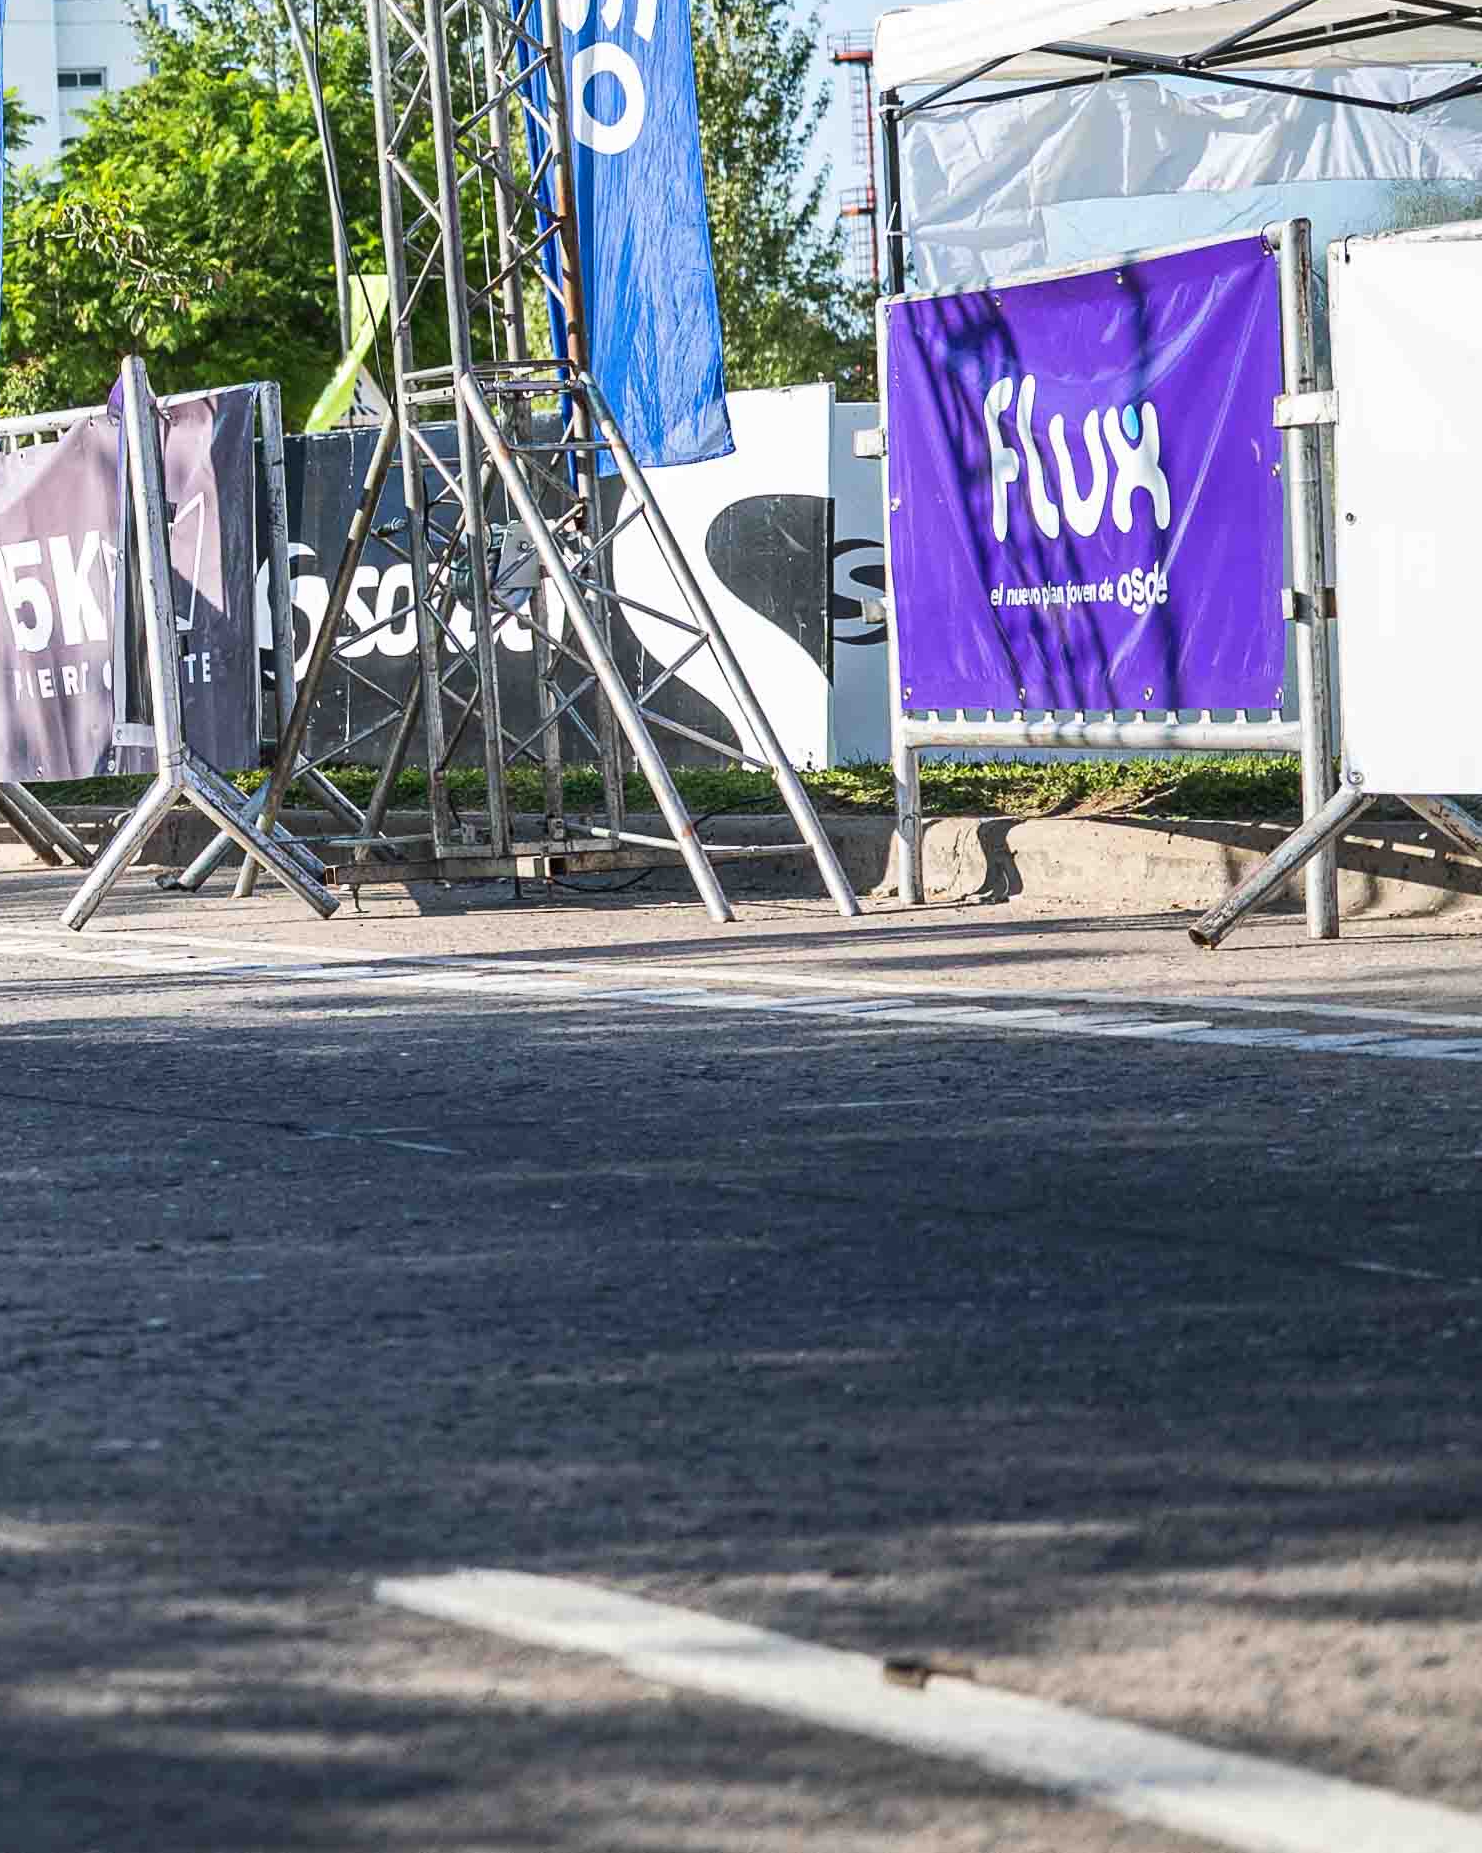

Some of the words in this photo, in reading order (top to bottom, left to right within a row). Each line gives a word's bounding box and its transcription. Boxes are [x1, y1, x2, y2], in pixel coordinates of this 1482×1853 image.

[984, 374, 1171, 542] flux
[990, 582, 1004, 606] el
[1006, 586, 1042, 606] nuevo
[1042, 581, 1064, 611] plan
[1066, 580, 1096, 611] joven
[1098, 577, 1114, 602] de
[1117, 561, 1168, 615] osde
